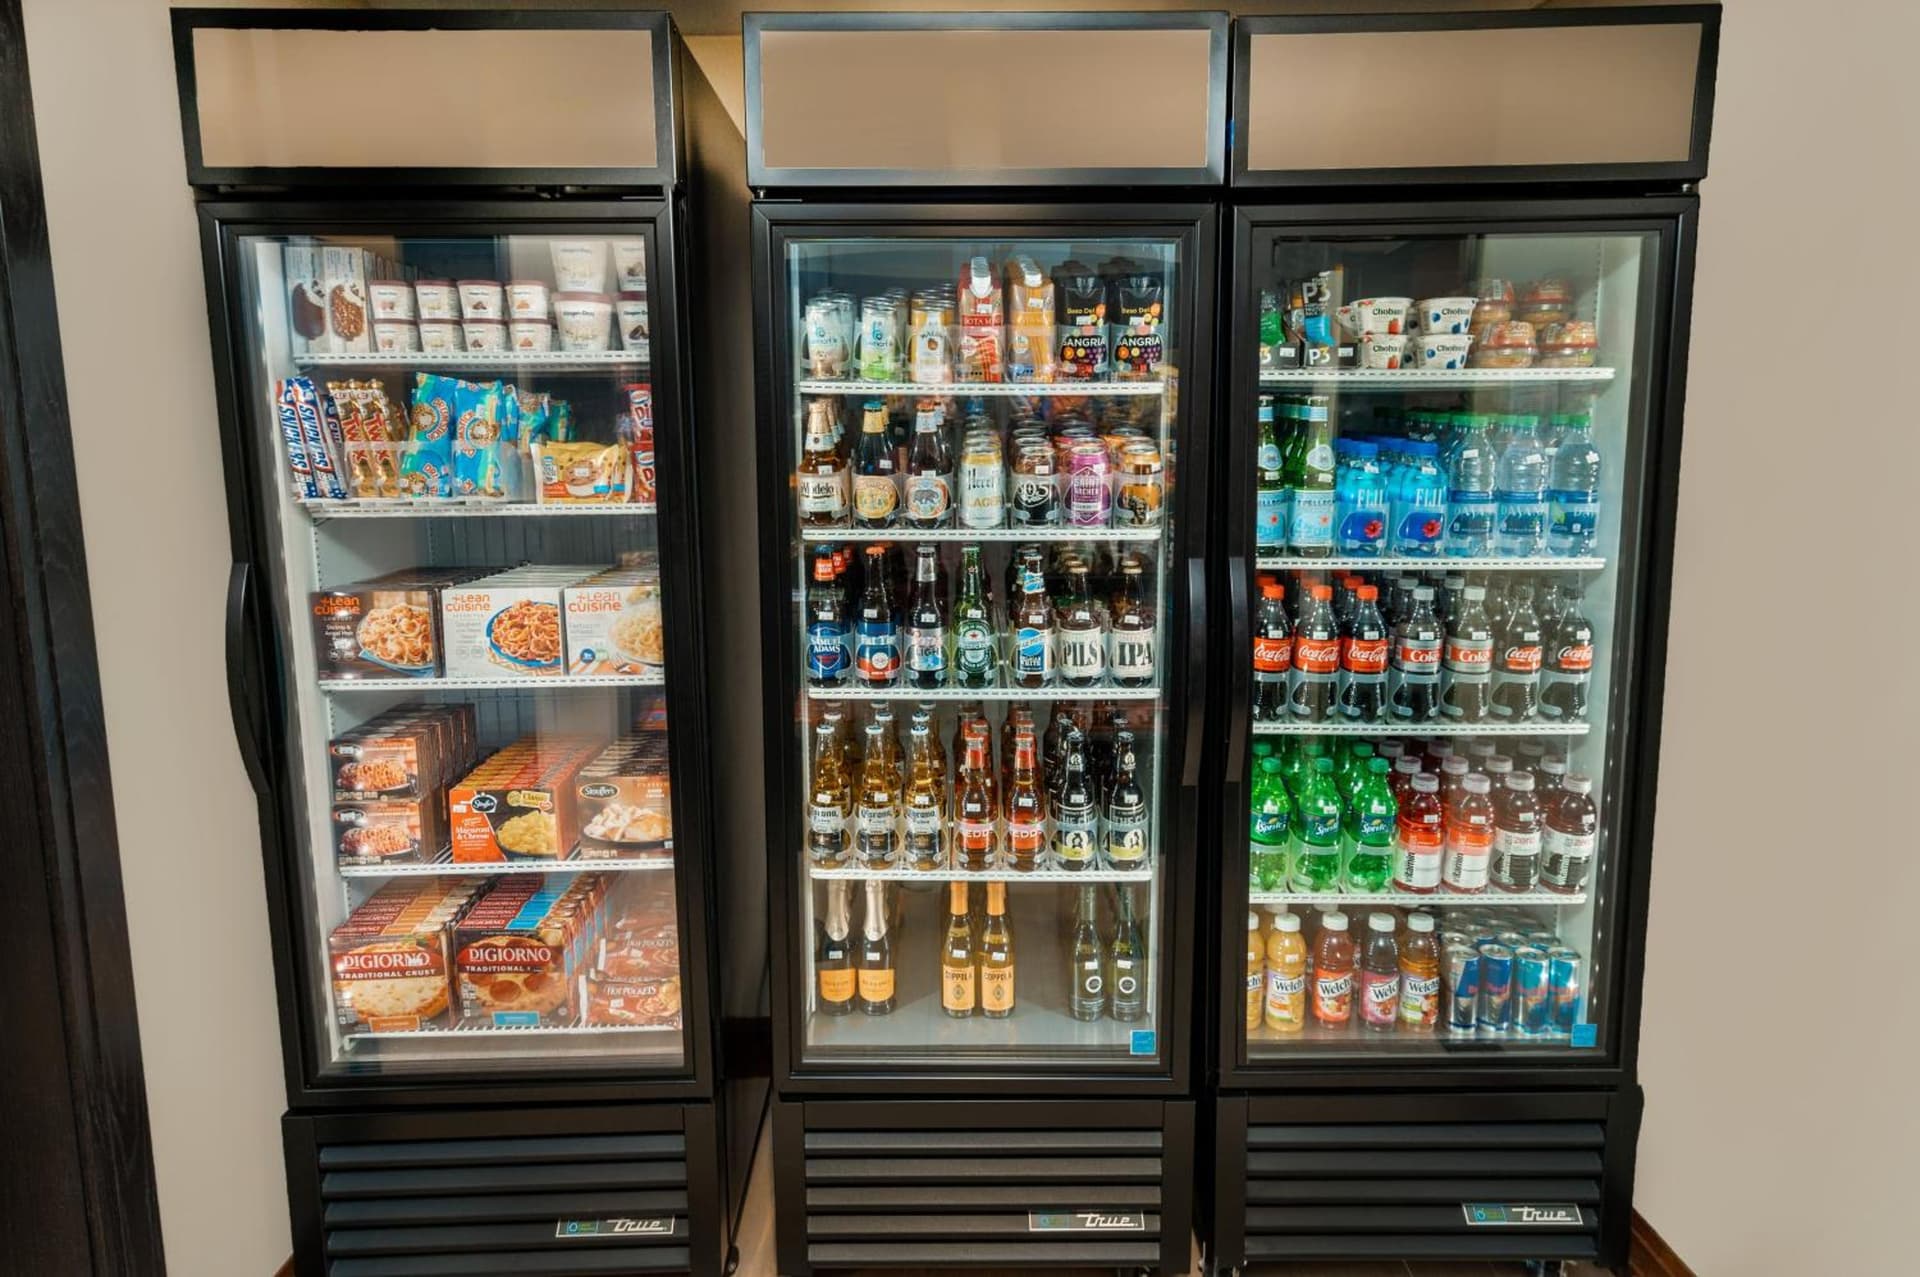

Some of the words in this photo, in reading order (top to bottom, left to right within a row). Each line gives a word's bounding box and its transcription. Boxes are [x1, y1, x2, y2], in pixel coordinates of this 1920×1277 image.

[1063, 336, 1107, 347] SANGRIA
[1119, 336, 1161, 347] SANGRIA
[1309, 346, 1331, 366] P3
[279, 404, 307, 469] SNICKERS
[299, 403, 329, 468] SNICKERS
[1357, 489, 1384, 509] FIJI
[1415, 488, 1442, 508] FIJI
[813, 645, 841, 653] ADAMS
[1064, 640, 1098, 666] PILS
[1117, 641, 1153, 666] IPA
[1298, 645, 1338, 663] Coca-Cola
[1347, 644, 1388, 663] Coca-Cola
[343, 952, 431, 968] DIGIORNO
[468, 947, 552, 962] DIGIORNO
[340, 971, 403, 980] TRADITIONAL
[406, 968, 436, 976] CRUST
